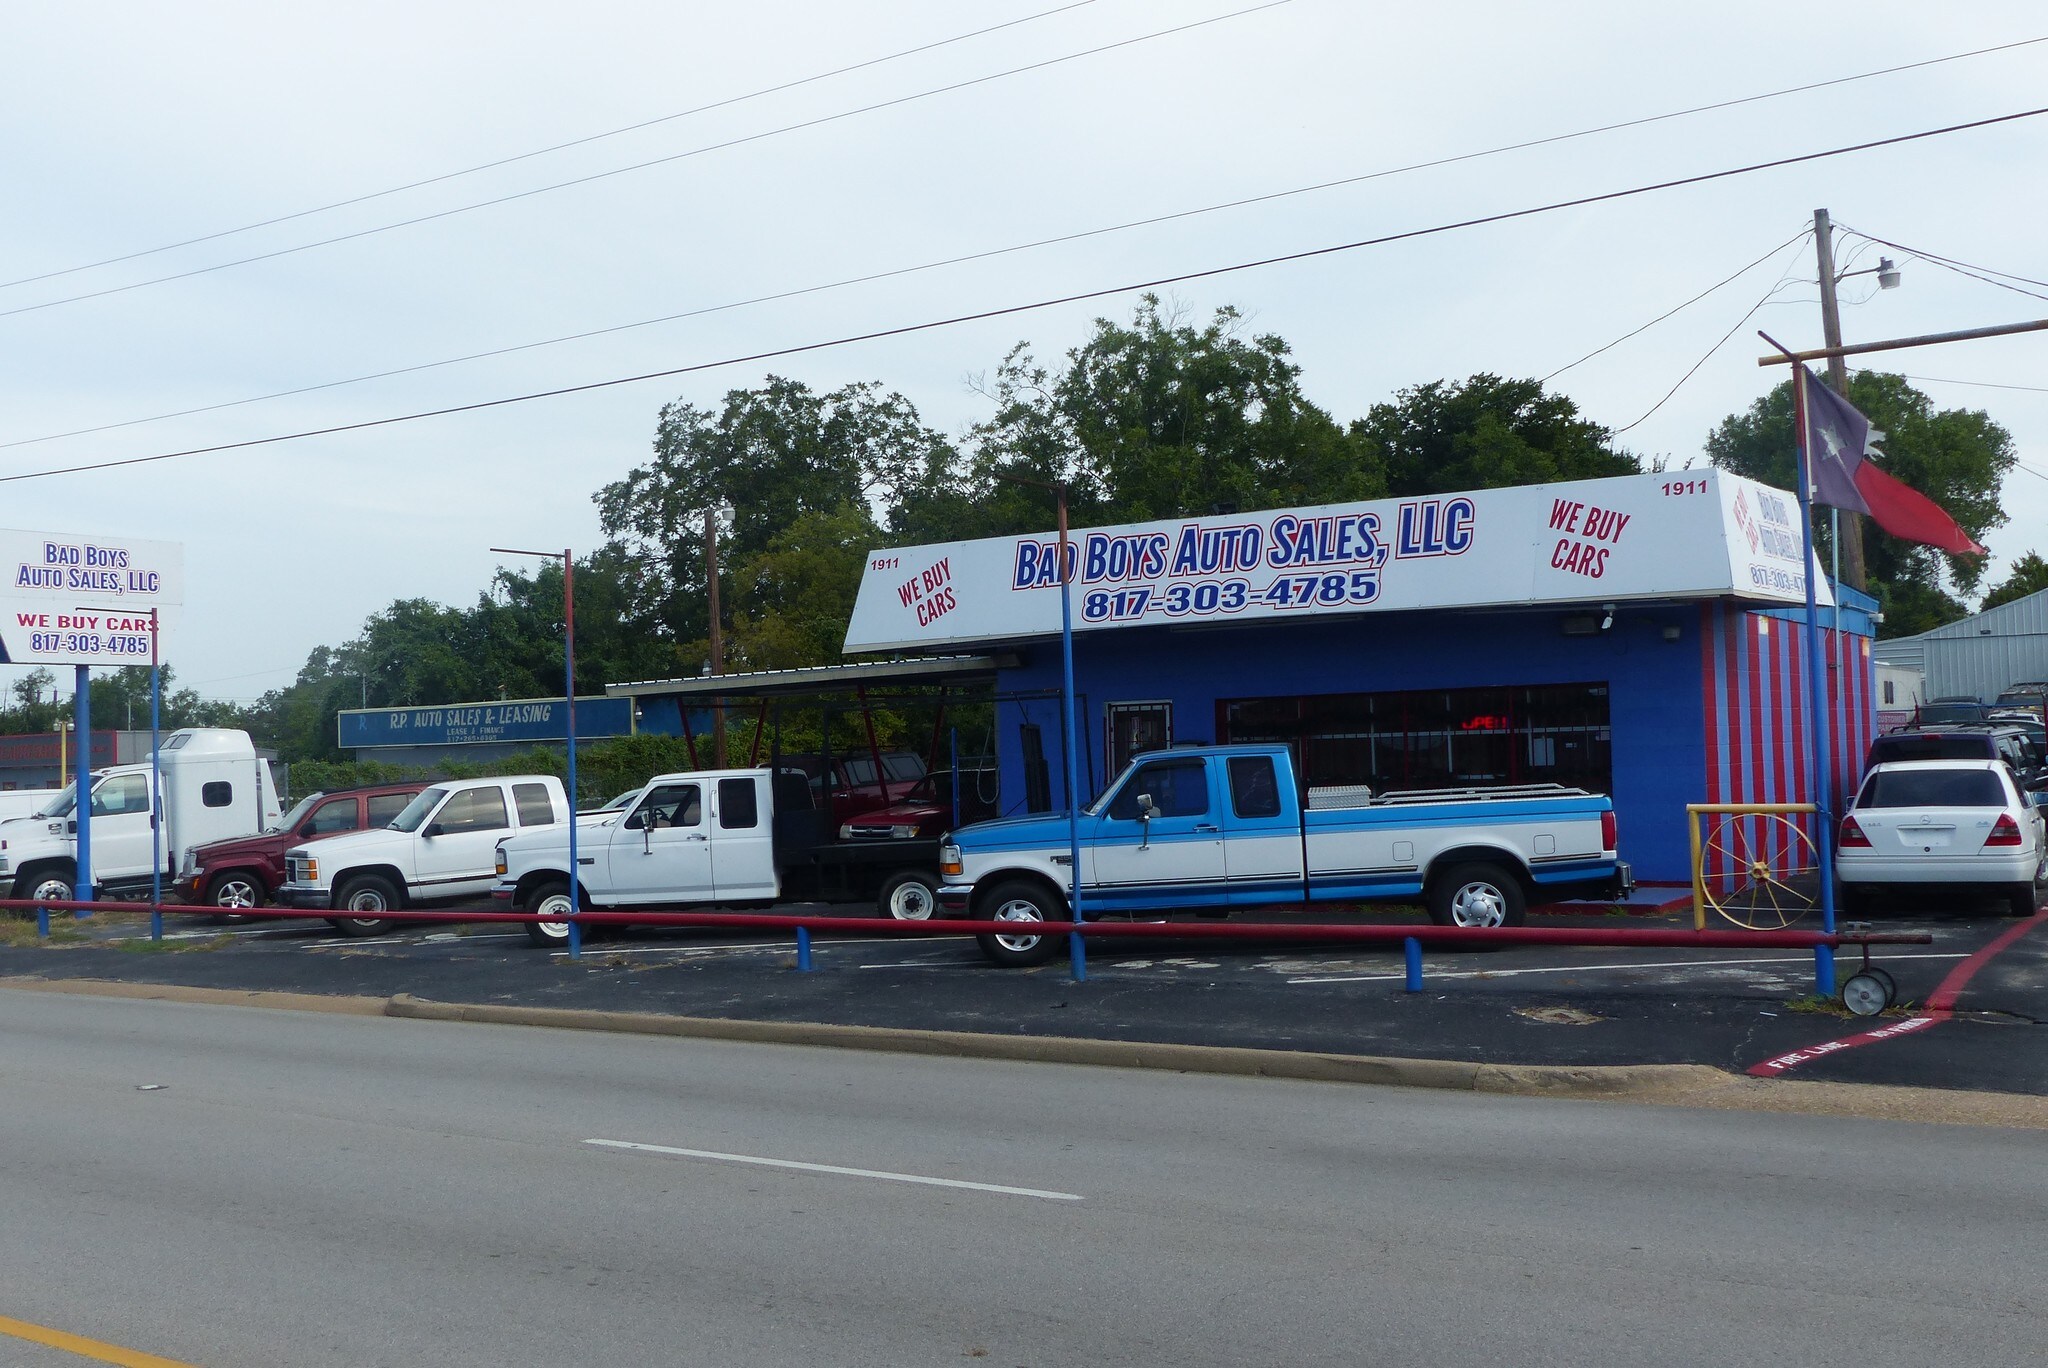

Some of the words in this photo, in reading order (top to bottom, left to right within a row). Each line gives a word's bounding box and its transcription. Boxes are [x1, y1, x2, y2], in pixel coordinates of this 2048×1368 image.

[1661, 480, 1707, 497] 1911
[1549, 498, 1584, 533] WE
[1582, 506, 1631, 544] BUY
[1081, 533, 1170, 584] BOYS
[1169, 524, 1264, 578] AUTO
[1266, 512, 1389, 569] SALES,
[1395, 497, 1475, 560] LLC
[44, 541, 82, 566] BAD
[84, 544, 130, 569] BOYS
[871, 557, 899, 571] 1911
[1550, 538, 1610, 579] CARS
[15, 563, 64, 589] AUTO
[68, 567, 126, 596] SALES,
[127, 570, 161, 594] LLC
[897, 576, 922, 608] WE
[921, 556, 951, 594] BUY
[916, 586, 957, 627] CARS
[1082, 566, 1381, 622] 817-303-4785
[17, 614, 50, 627] WE
[58, 615, 99, 629] BUY
[106, 617, 160, 632] CARS
[30, 631, 149, 656] 817-303-4785
[414, 710, 442, 728] AUTO
[446, 708, 481, 727] SALES
[485, 708, 496, 725] &
[499, 704, 552, 725] LEASING
[446, 727, 468, 736] LEASE
[1766, 1053, 1810, 1068] FIRE
